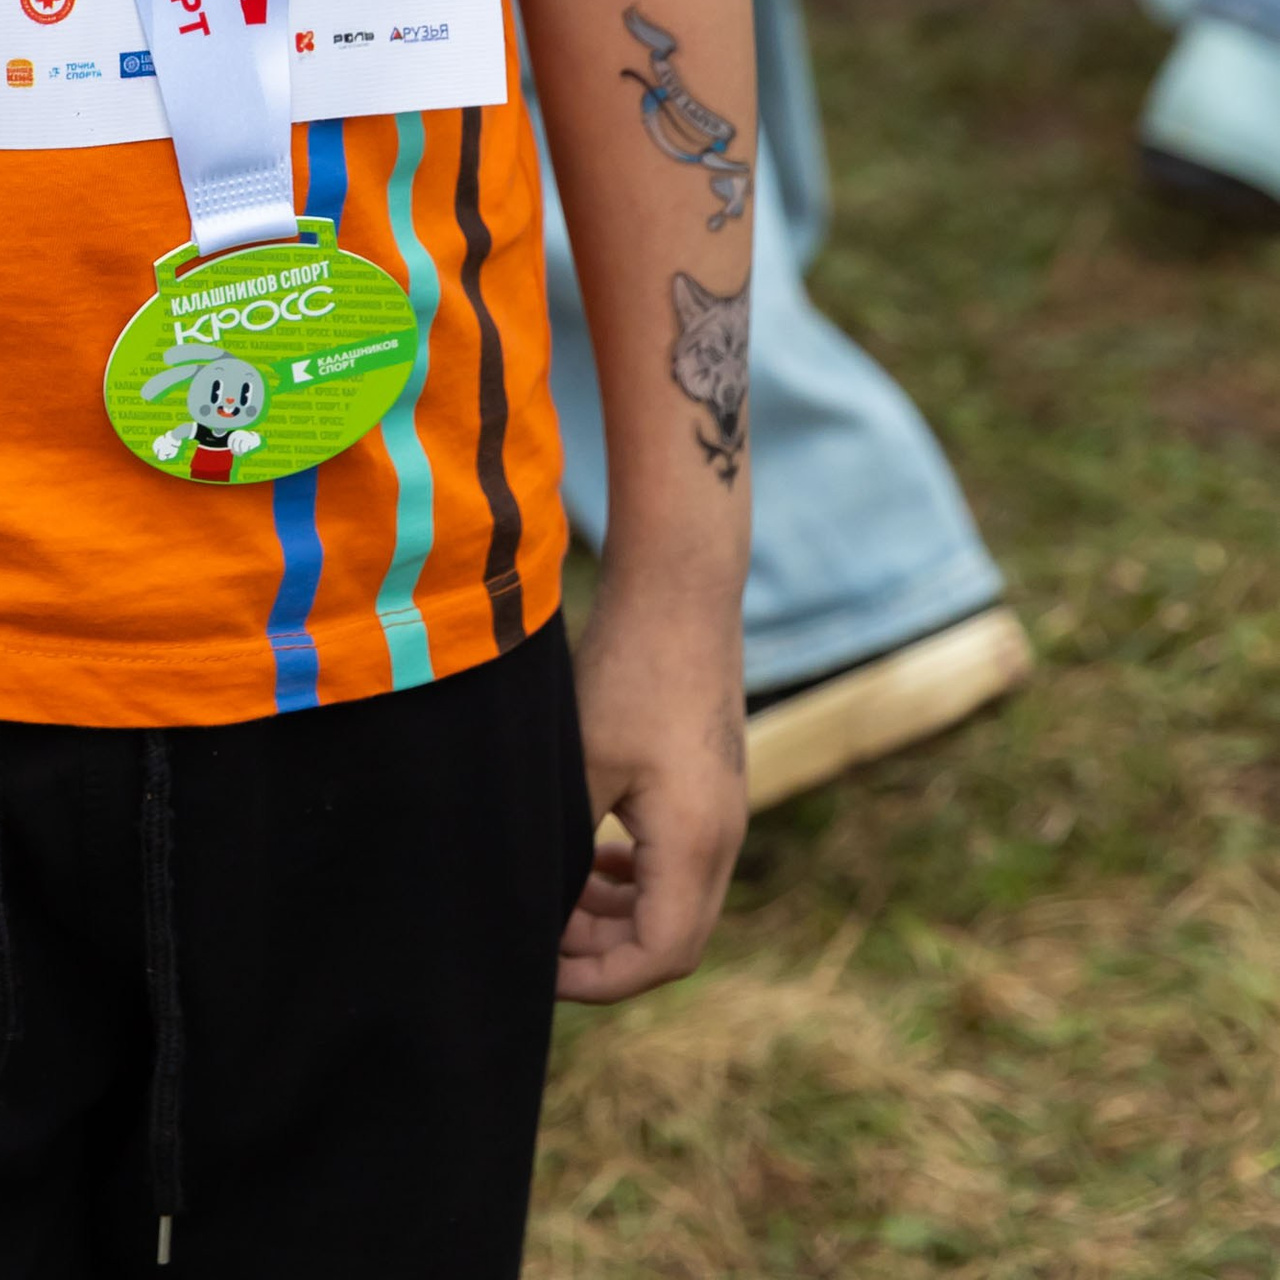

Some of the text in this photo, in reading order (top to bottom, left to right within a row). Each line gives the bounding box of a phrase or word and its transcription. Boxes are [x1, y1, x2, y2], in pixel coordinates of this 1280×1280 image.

[171, 260, 330, 317] КАЛАШНИКОВ СПОРТ
[173, 285, 336, 345] КРОСС
[317, 339, 399, 368] КАЛАШНИКОВ
[318, 358, 356, 376] СПОРТ
